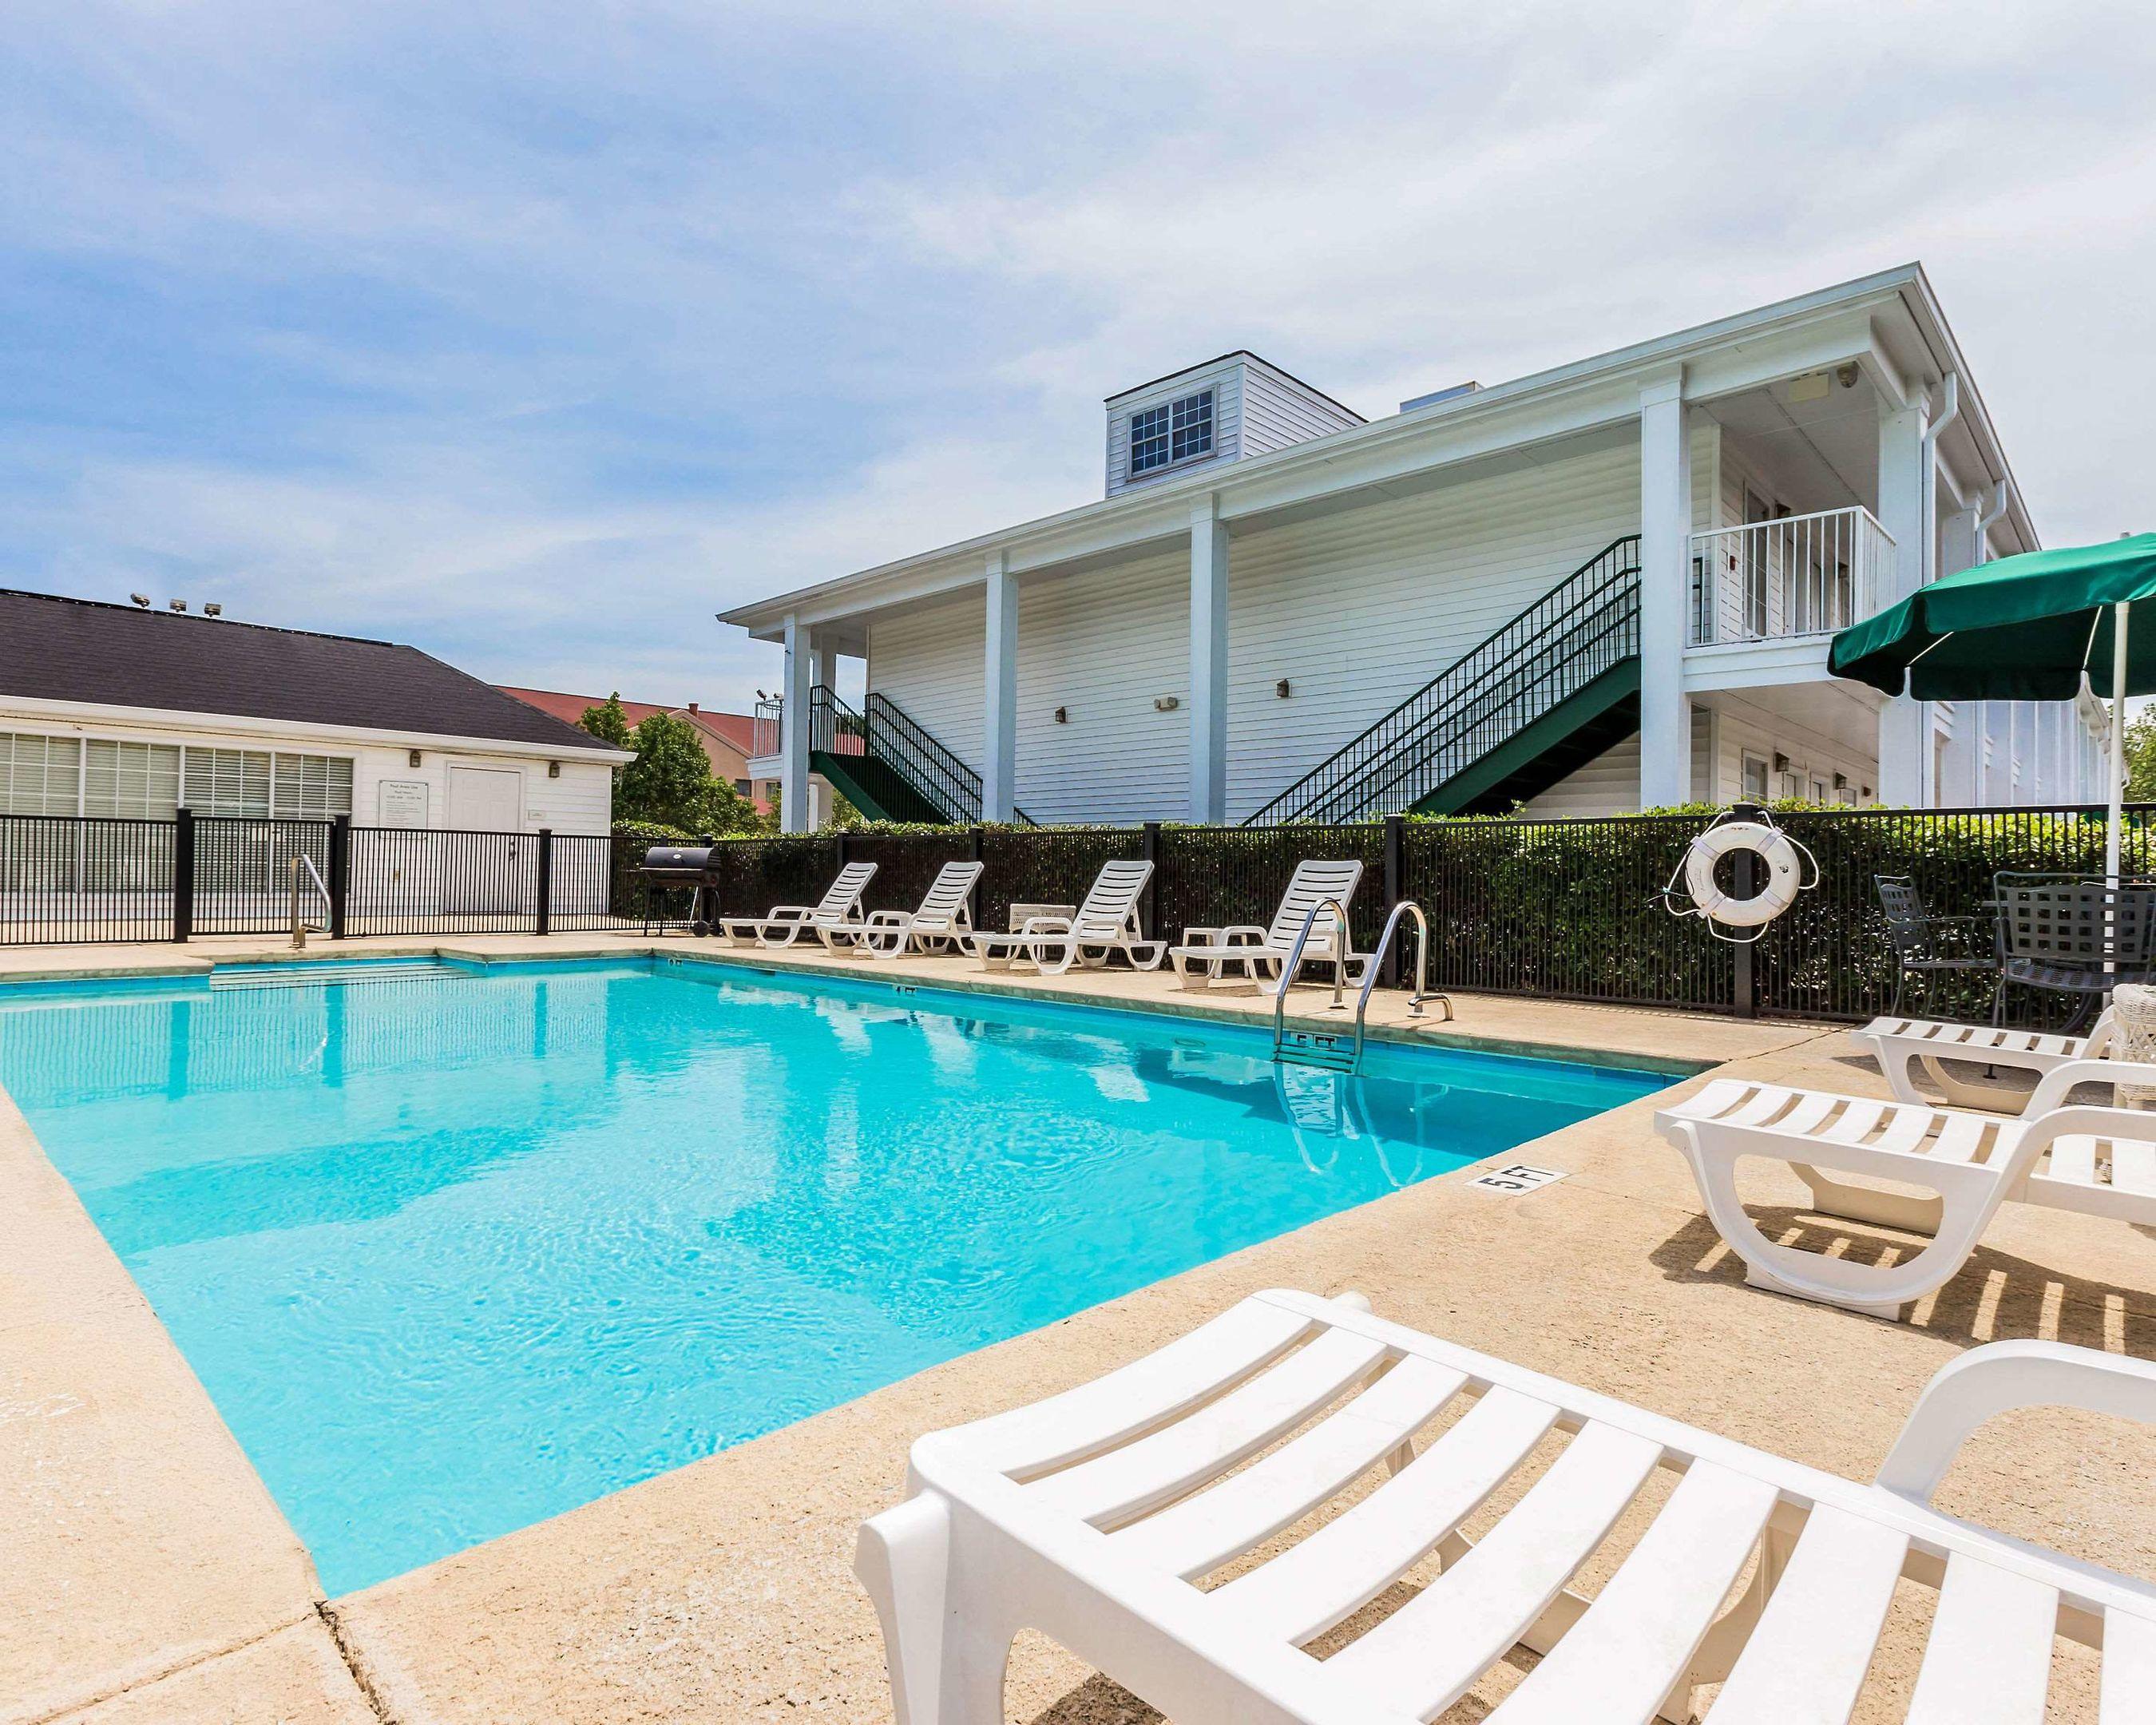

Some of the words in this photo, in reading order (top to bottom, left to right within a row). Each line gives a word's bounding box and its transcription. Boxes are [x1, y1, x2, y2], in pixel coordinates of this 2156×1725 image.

[1315, 1036, 1335, 1048] FT
[1500, 1165, 1555, 1182] FT
[1478, 1177, 1524, 1189] 5
